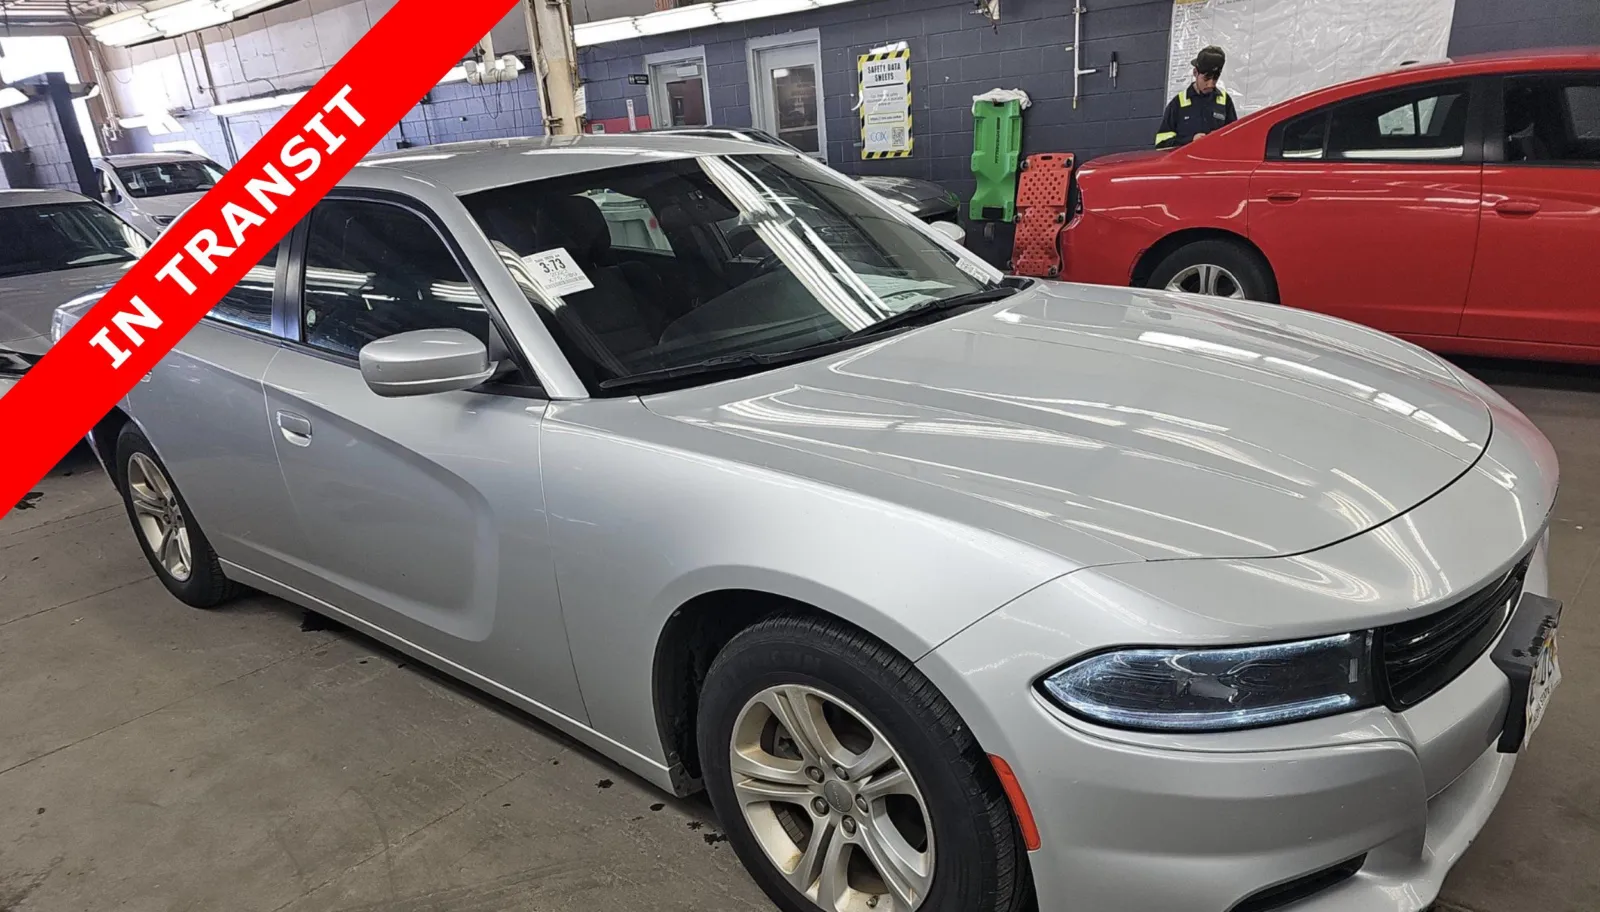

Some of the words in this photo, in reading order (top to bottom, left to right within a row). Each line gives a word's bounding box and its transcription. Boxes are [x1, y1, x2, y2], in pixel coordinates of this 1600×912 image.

[867, 64, 886, 74] SAFETY
[887, 62, 901, 72] DATA
[870, 131, 887, 142] COX
